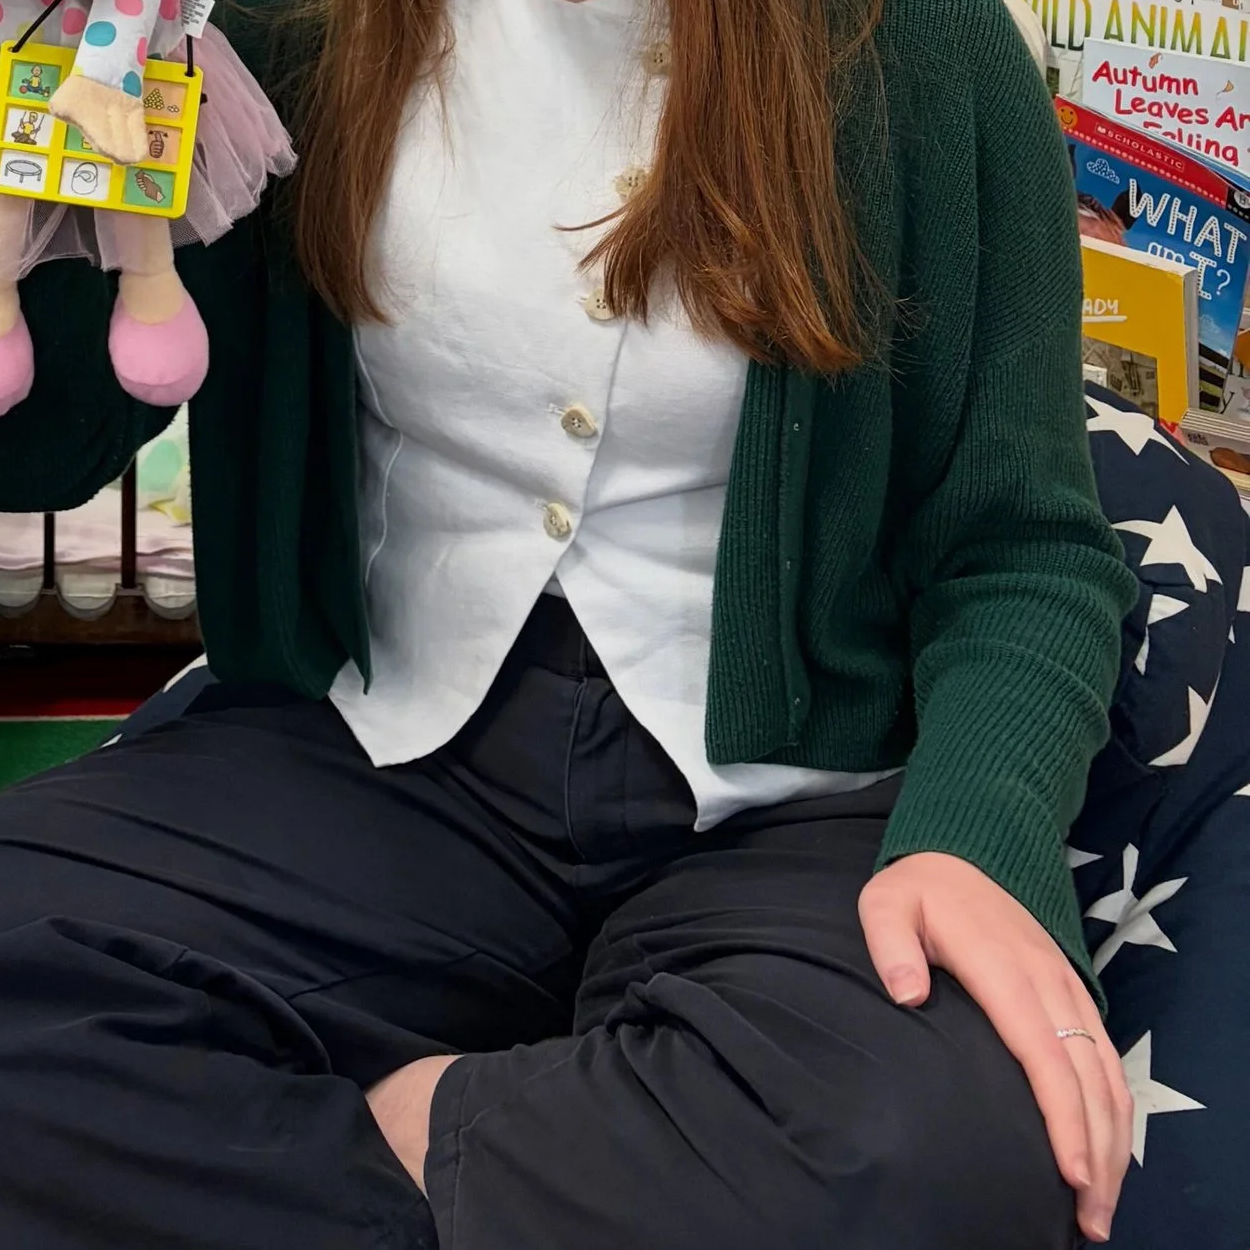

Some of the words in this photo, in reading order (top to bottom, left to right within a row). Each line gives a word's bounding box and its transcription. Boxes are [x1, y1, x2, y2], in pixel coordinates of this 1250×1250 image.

[1092, 60, 1199, 96] Autumn
[1115, 88, 1210, 125] Leaves
[1107, 129, 1183, 169] SCHOLASTIC
[1129, 178, 1247, 264] WHAT
